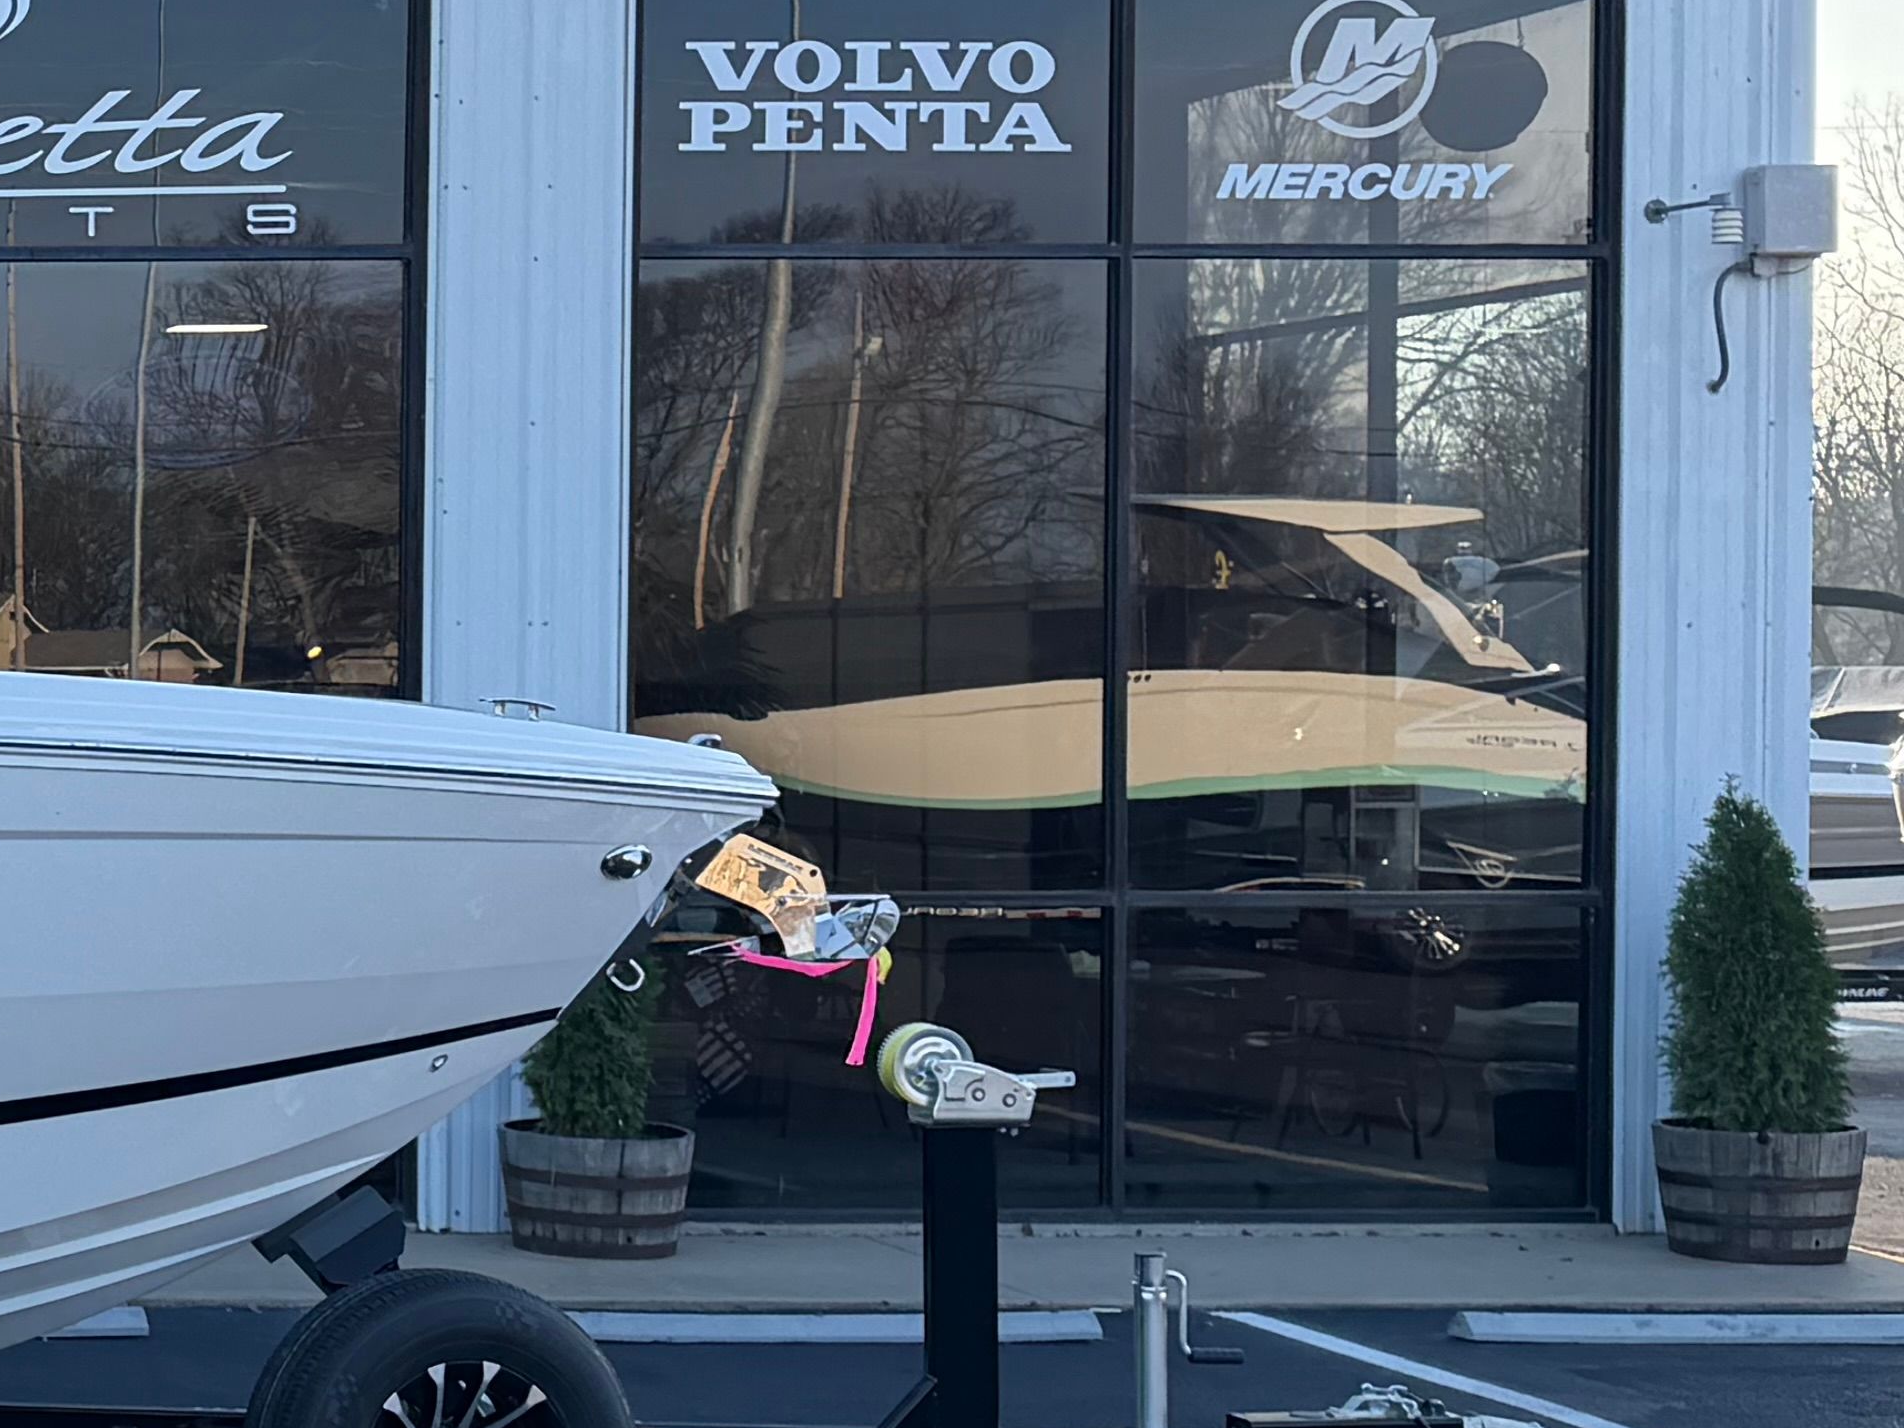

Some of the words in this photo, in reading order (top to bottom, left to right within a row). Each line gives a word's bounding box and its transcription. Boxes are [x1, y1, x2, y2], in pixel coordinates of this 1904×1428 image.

[685, 40, 1056, 93] VOLVO
[678, 101, 1072, 152] PENTA
[1216, 163, 1514, 200] MERCURY
